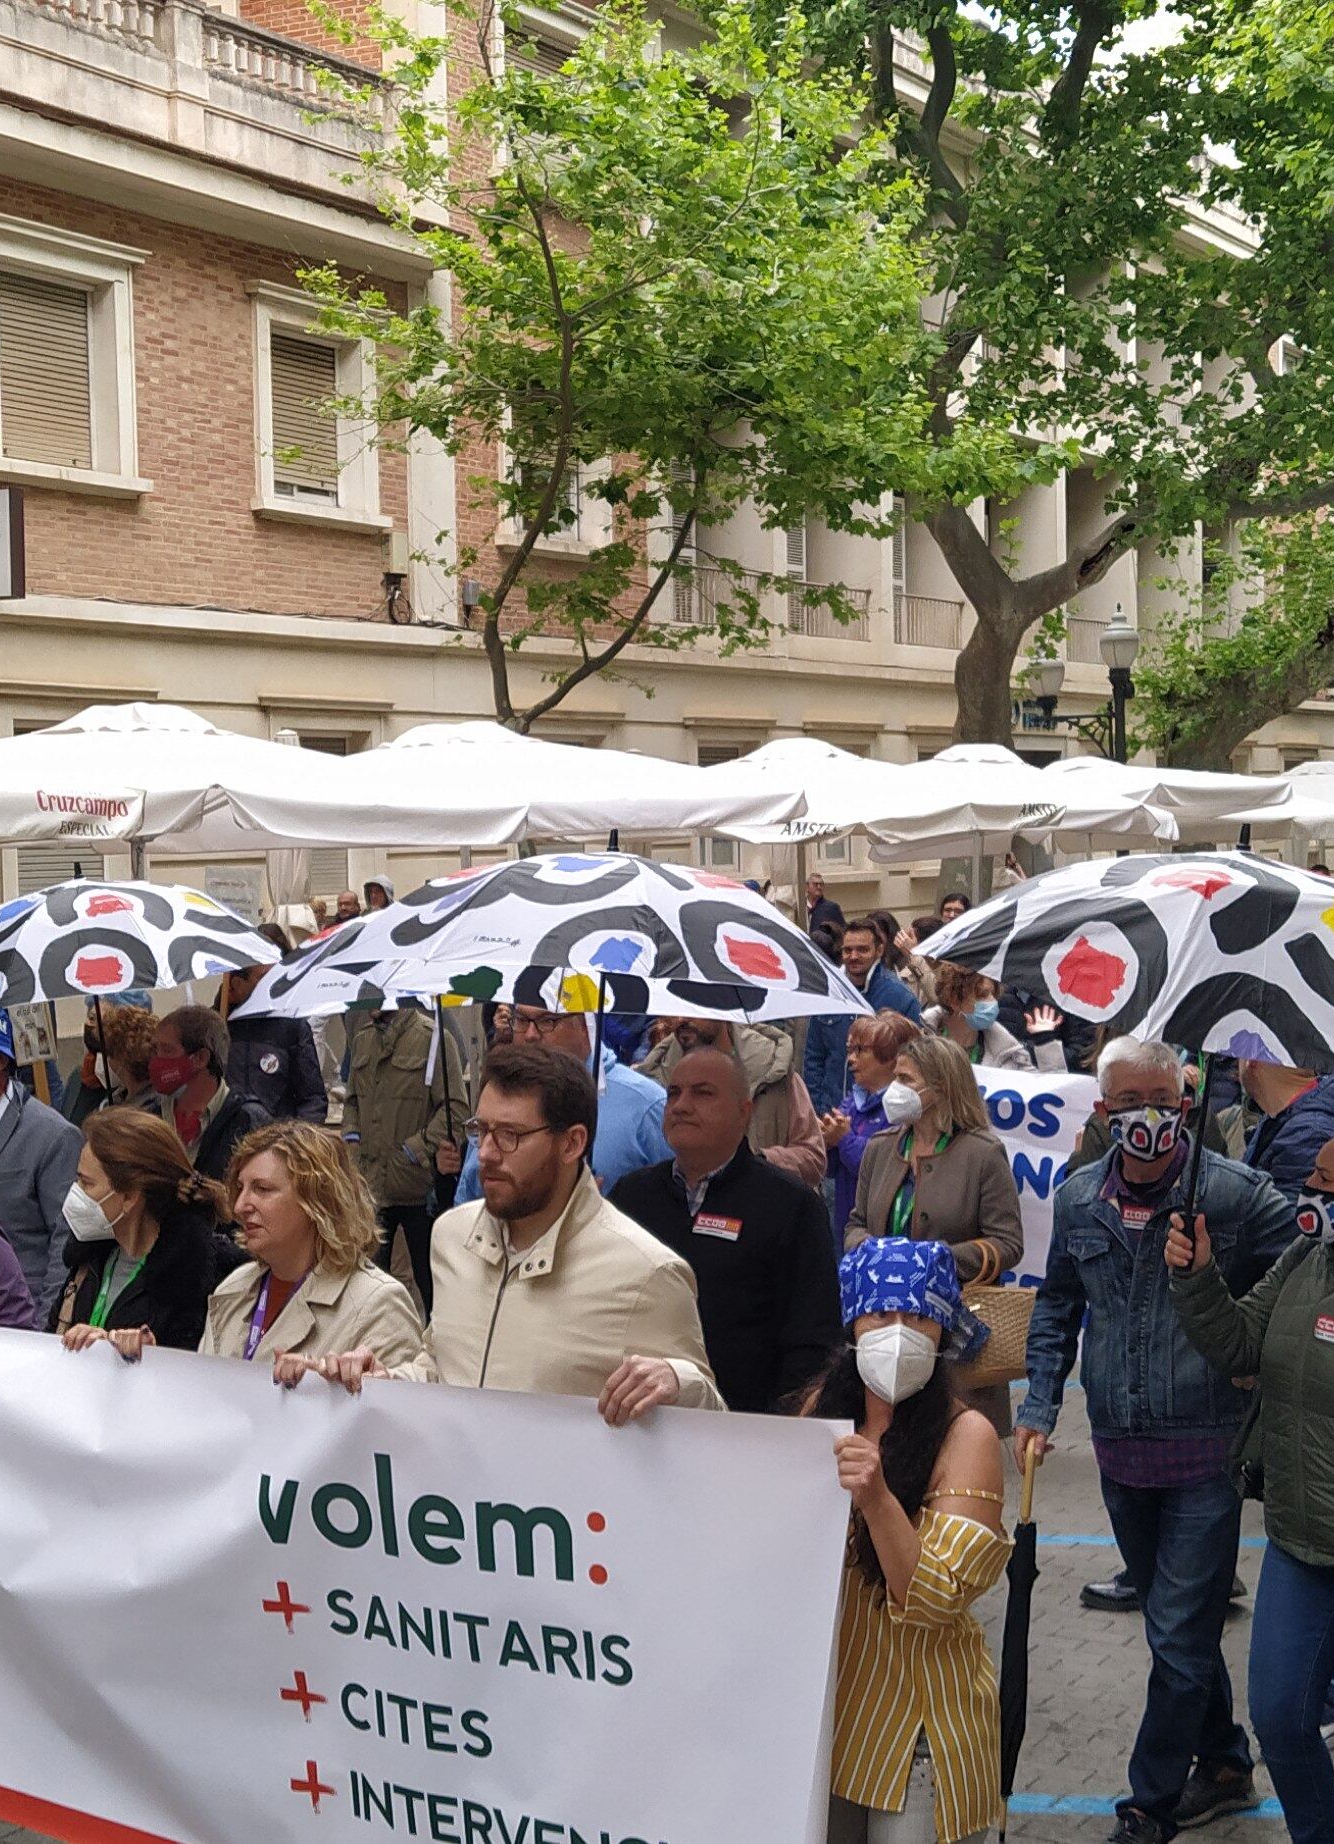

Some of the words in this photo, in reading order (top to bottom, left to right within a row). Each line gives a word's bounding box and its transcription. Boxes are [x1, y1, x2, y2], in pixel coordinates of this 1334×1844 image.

[36, 789, 129, 821] Cruzcampo
[59, 820, 117, 837] ESPECIAL
[979, 1085, 1065, 1138] OS
[258, 1452, 609, 1585] volem:
[326, 1588, 634, 1687] SANITARIS
[340, 1682, 494, 1759] CITES
